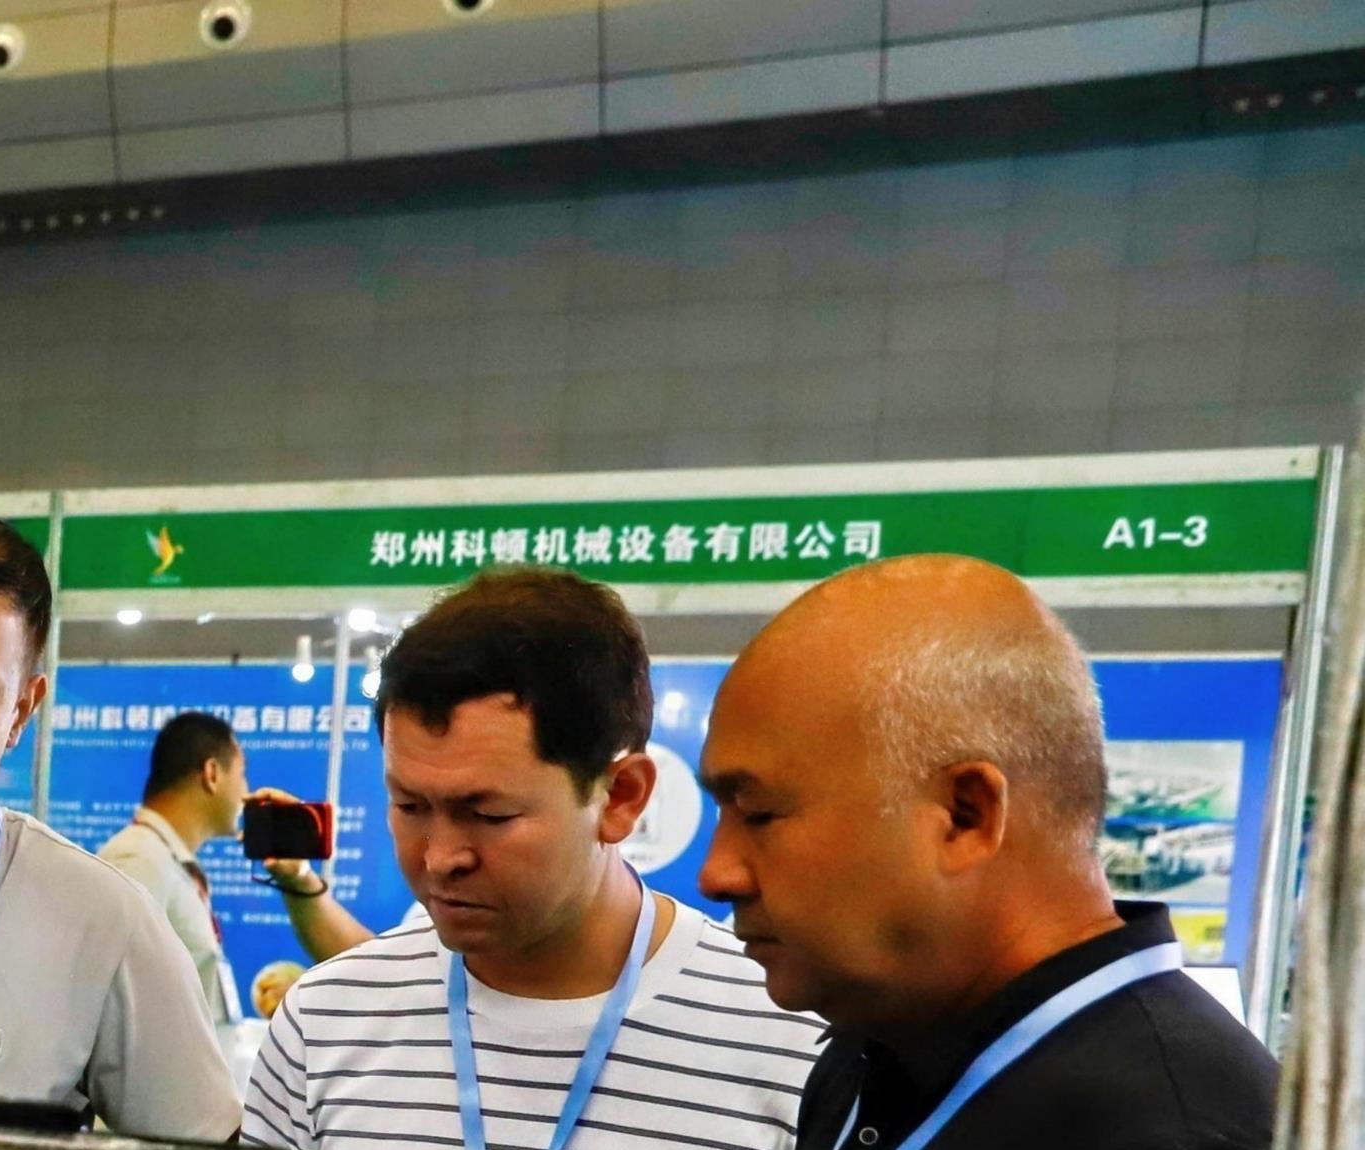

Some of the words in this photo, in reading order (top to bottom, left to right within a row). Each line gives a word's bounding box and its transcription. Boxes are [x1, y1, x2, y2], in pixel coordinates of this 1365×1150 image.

[370, 520, 882, 568] 郑州科顿机械设备有限公司
[1103, 516, 1208, 549] A1-3
